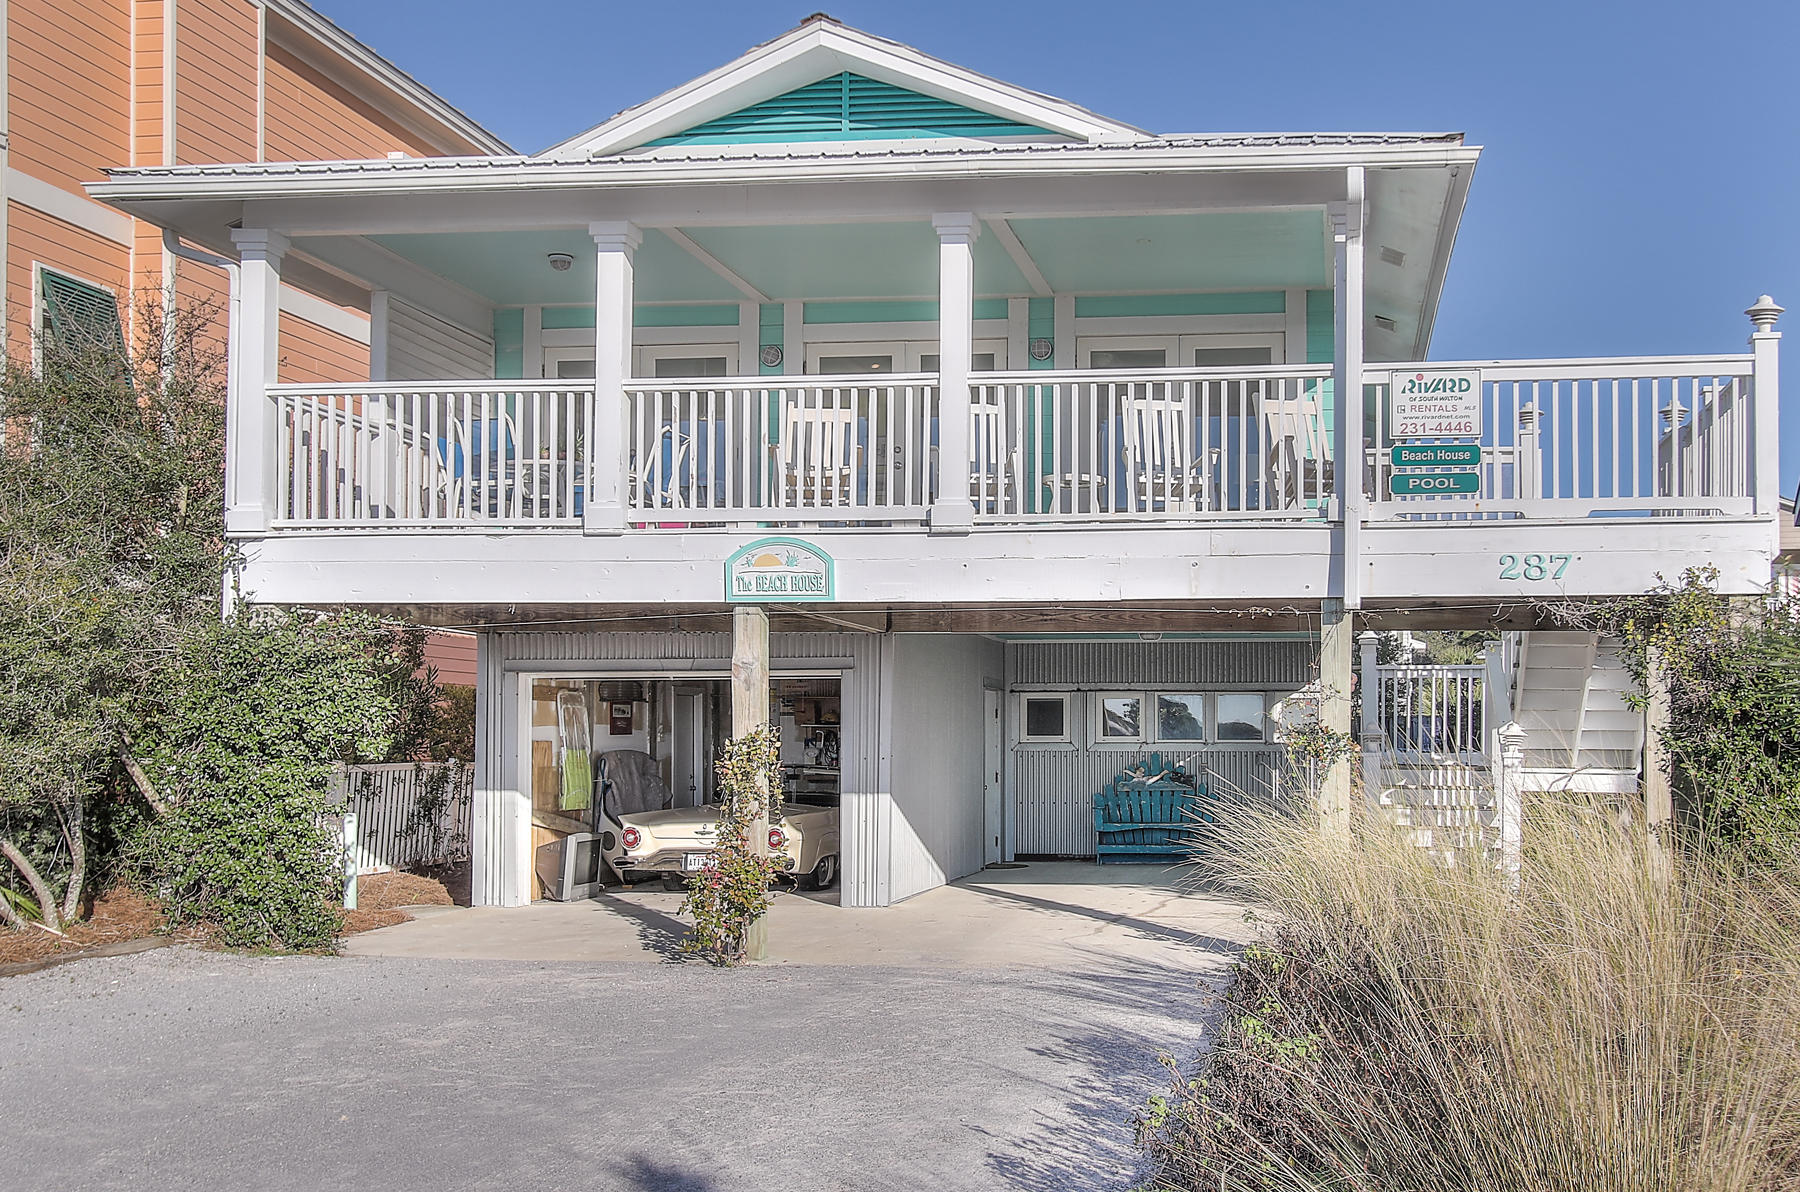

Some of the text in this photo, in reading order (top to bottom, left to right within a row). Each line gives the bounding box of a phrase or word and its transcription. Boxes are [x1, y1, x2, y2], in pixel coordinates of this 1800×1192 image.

[1400, 421, 1473, 434] 231-4446
[1401, 450, 1470, 461] Beach House
[1408, 478, 1461, 489] POOL
[1499, 554, 1572, 580] 287
[736, 573, 824, 592] The BEACH HOUSE
